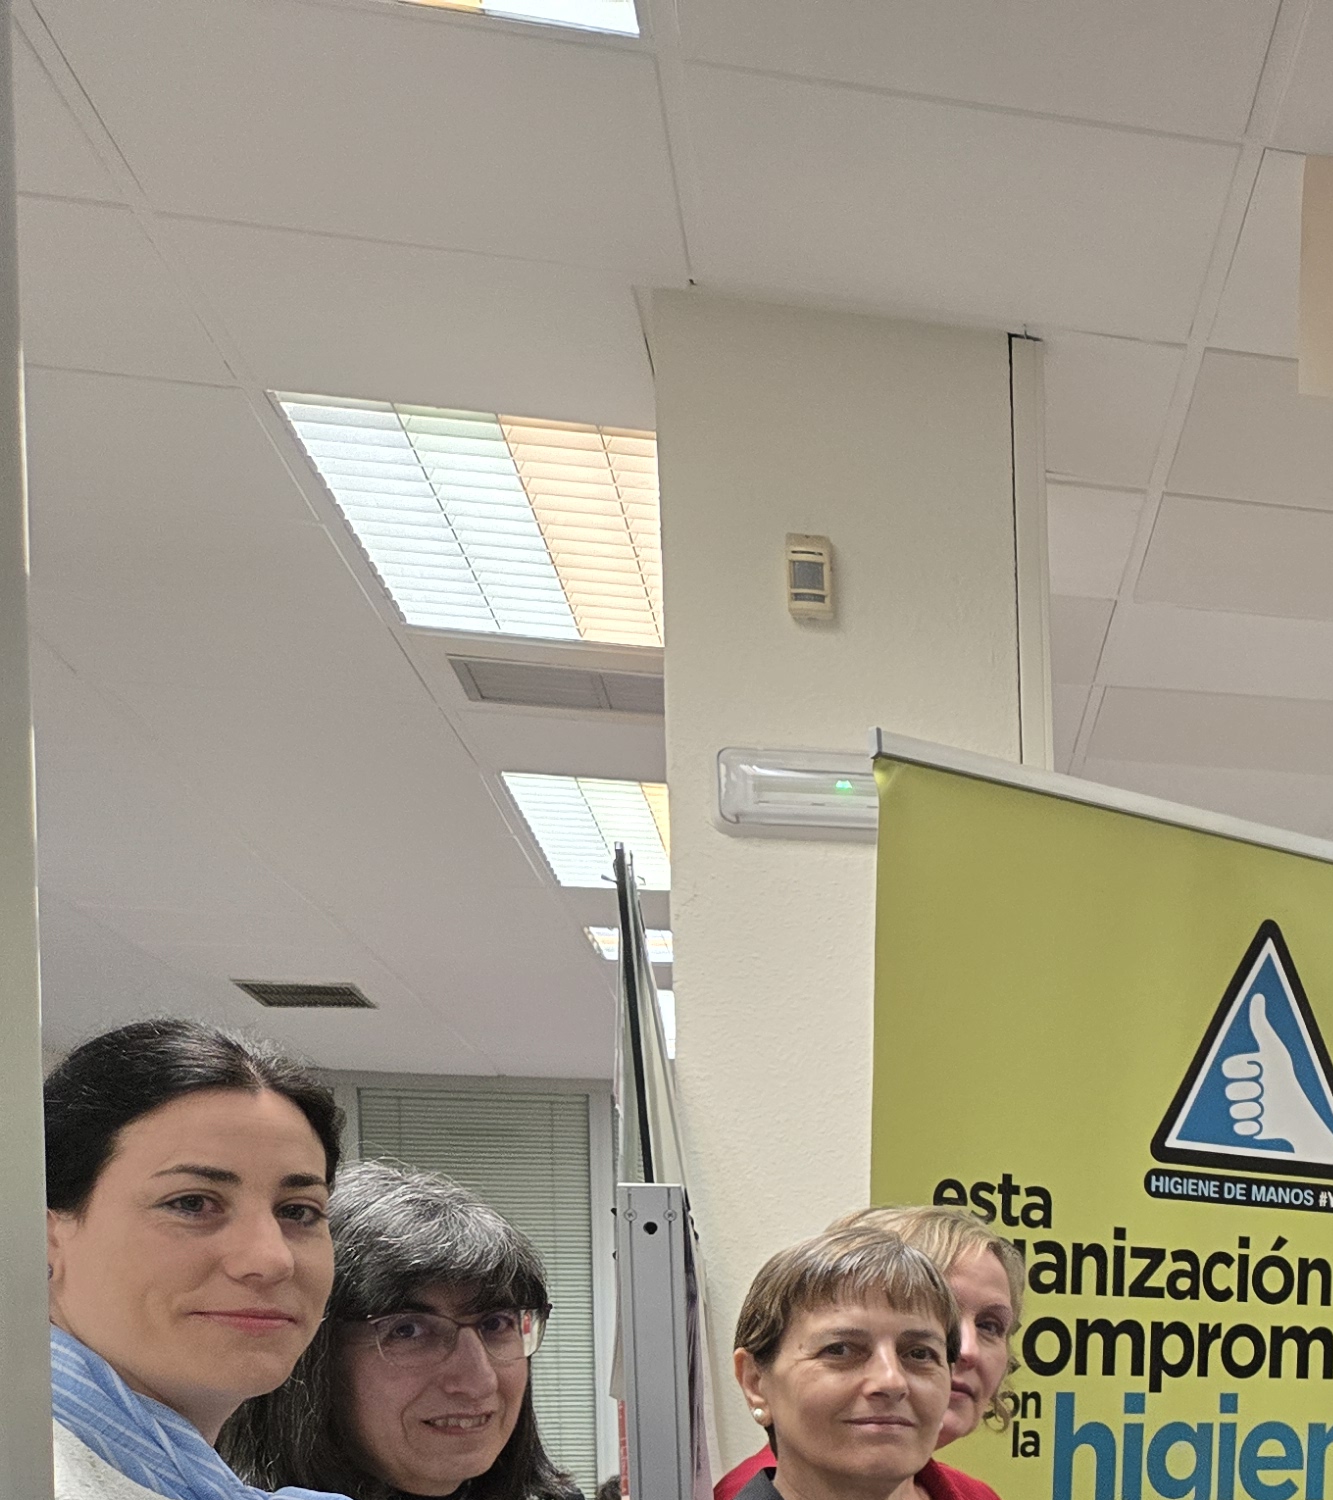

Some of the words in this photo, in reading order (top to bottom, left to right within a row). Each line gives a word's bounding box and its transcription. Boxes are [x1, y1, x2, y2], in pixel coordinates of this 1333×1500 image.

[932, 1172, 1053, 1230] esta
[1150, 1174, 1220, 1199] HIGIENE
[1223, 1182, 1248, 1201] DE
[1251, 1184, 1315, 1207] MANOS
[1010, 1226, 1333, 1307] anización
[1011, 1420, 1041, 1459] la
